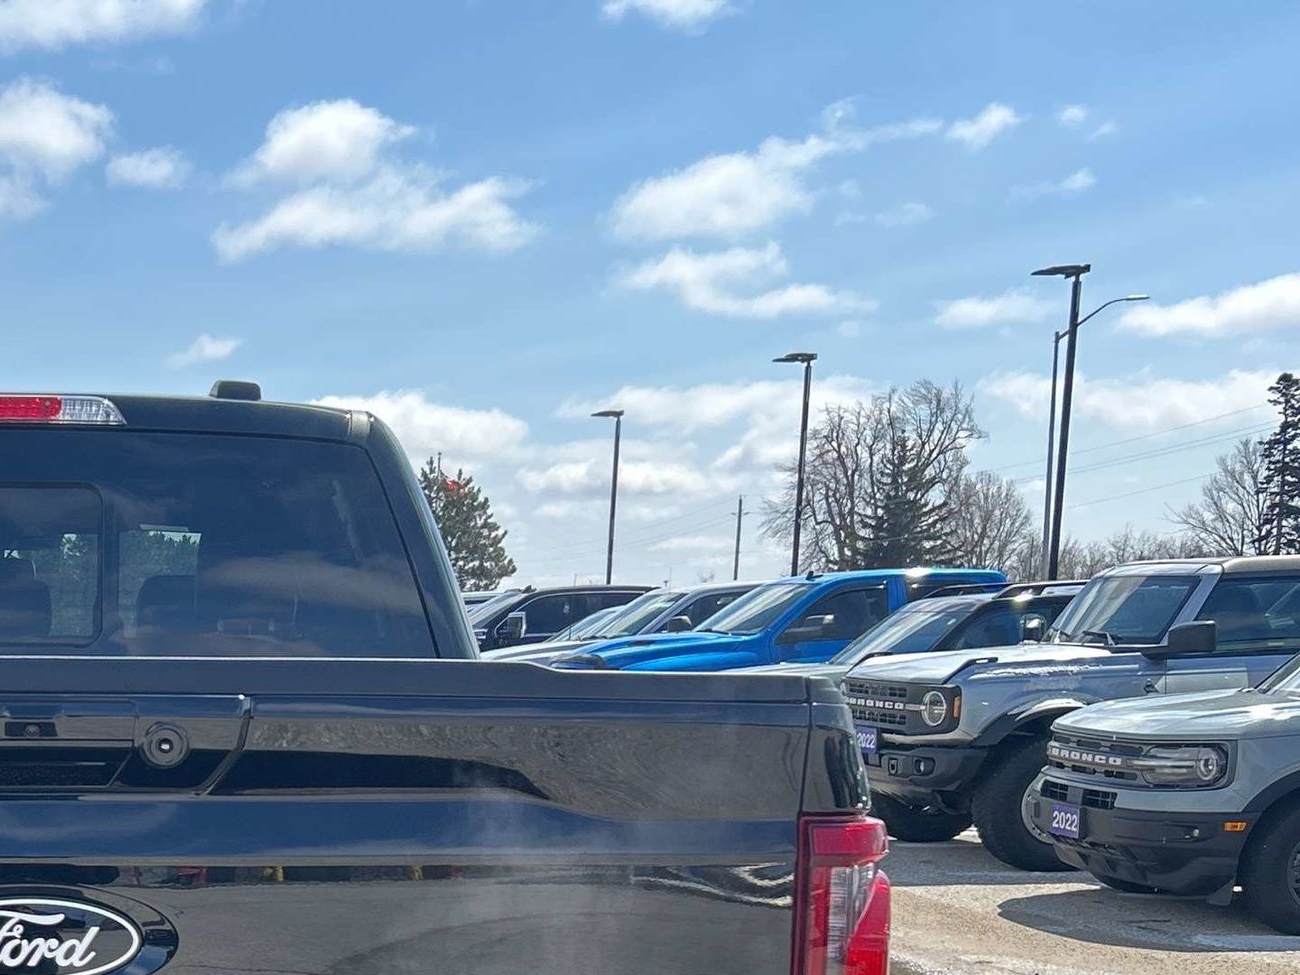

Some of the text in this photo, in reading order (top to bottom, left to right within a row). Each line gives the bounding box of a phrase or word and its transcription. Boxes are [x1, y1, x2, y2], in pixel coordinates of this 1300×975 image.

[850, 698, 904, 710] BRONCO
[857, 733, 876, 749] 2022
[1051, 747, 1122, 765] BRONCO
[1052, 811, 1078, 831] 2022
